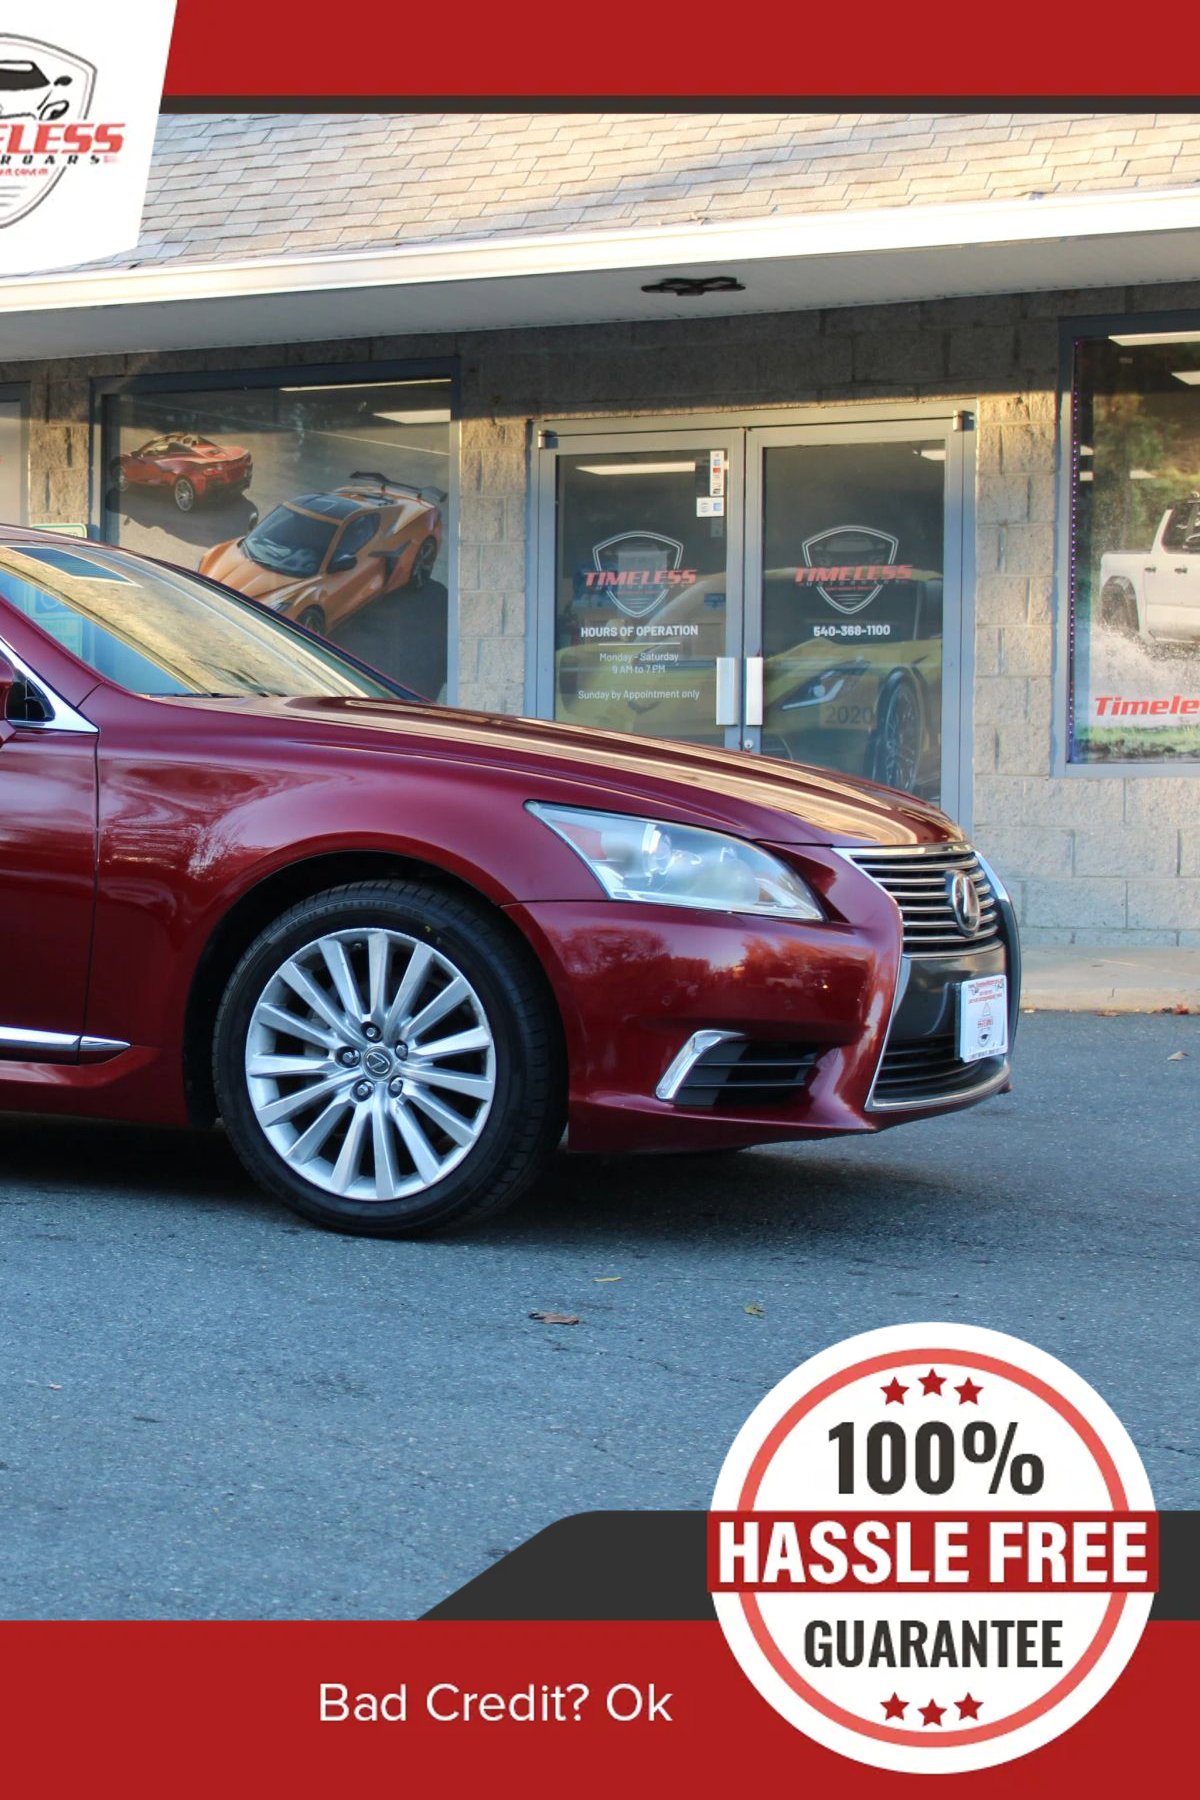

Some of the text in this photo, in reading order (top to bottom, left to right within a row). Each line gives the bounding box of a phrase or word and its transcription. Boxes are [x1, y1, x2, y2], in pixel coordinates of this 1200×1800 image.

[584, 569, 697, 587] TIMELESS
[794, 565, 912, 582] TIMELESS
[581, 625, 698, 637] HOURS OF OPERATION
[813, 624, 891, 637] 540-368-1100
[600, 653, 632, 664] Monday
[640, 651, 679, 663] Saturday
[620, 665, 633, 674] AM
[635, 665, 644, 674] to
[652, 665, 666, 673] PM
[578, 689, 700, 701] Sunday by Appointment only
